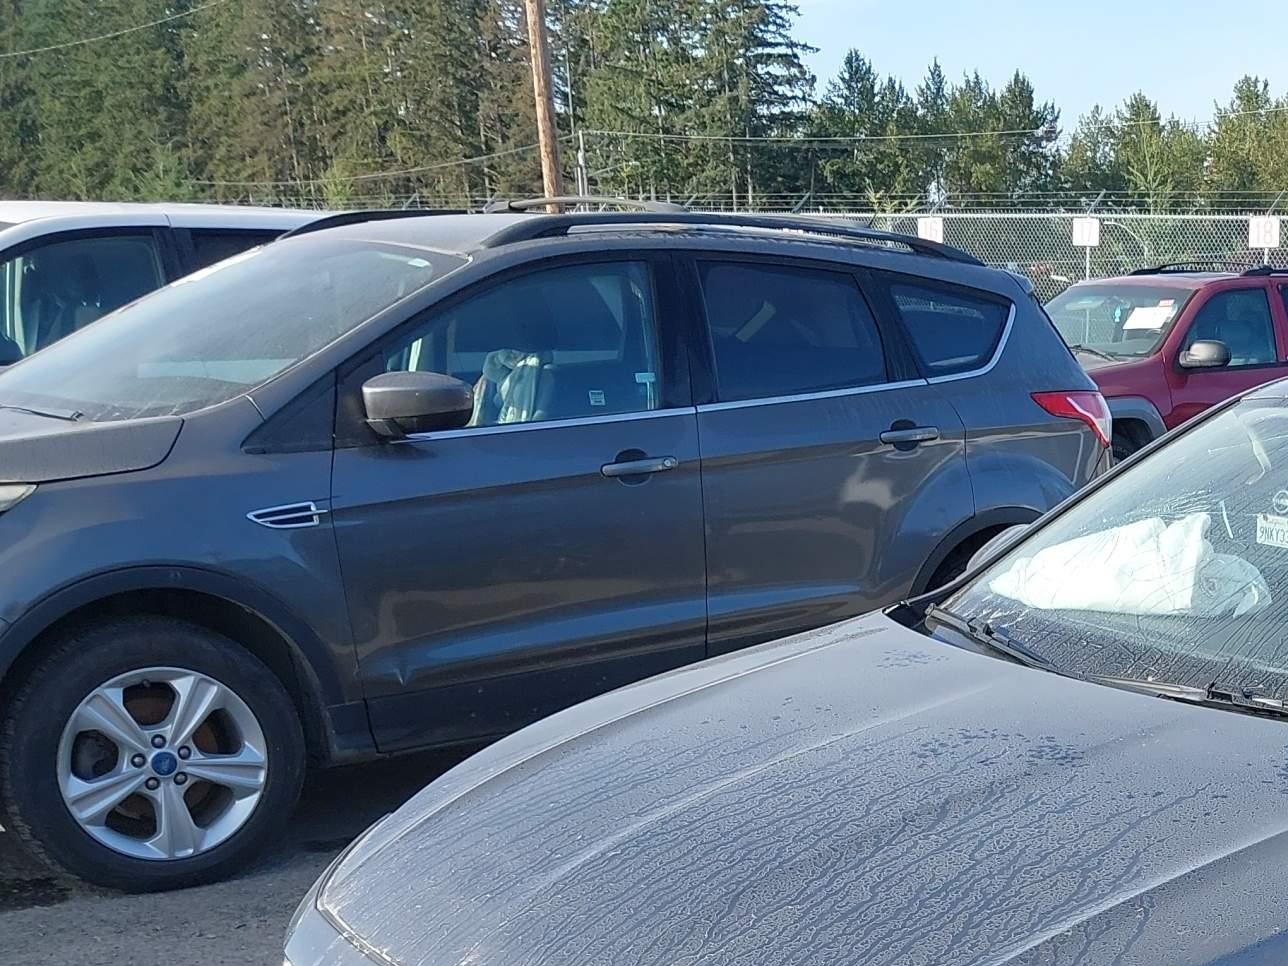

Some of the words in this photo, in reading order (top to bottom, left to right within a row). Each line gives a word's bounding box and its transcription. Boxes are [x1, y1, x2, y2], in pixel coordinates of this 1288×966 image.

[924, 220, 939, 240] 16
[1079, 221, 1094, 242] 17
[1256, 220, 1273, 245] 18
